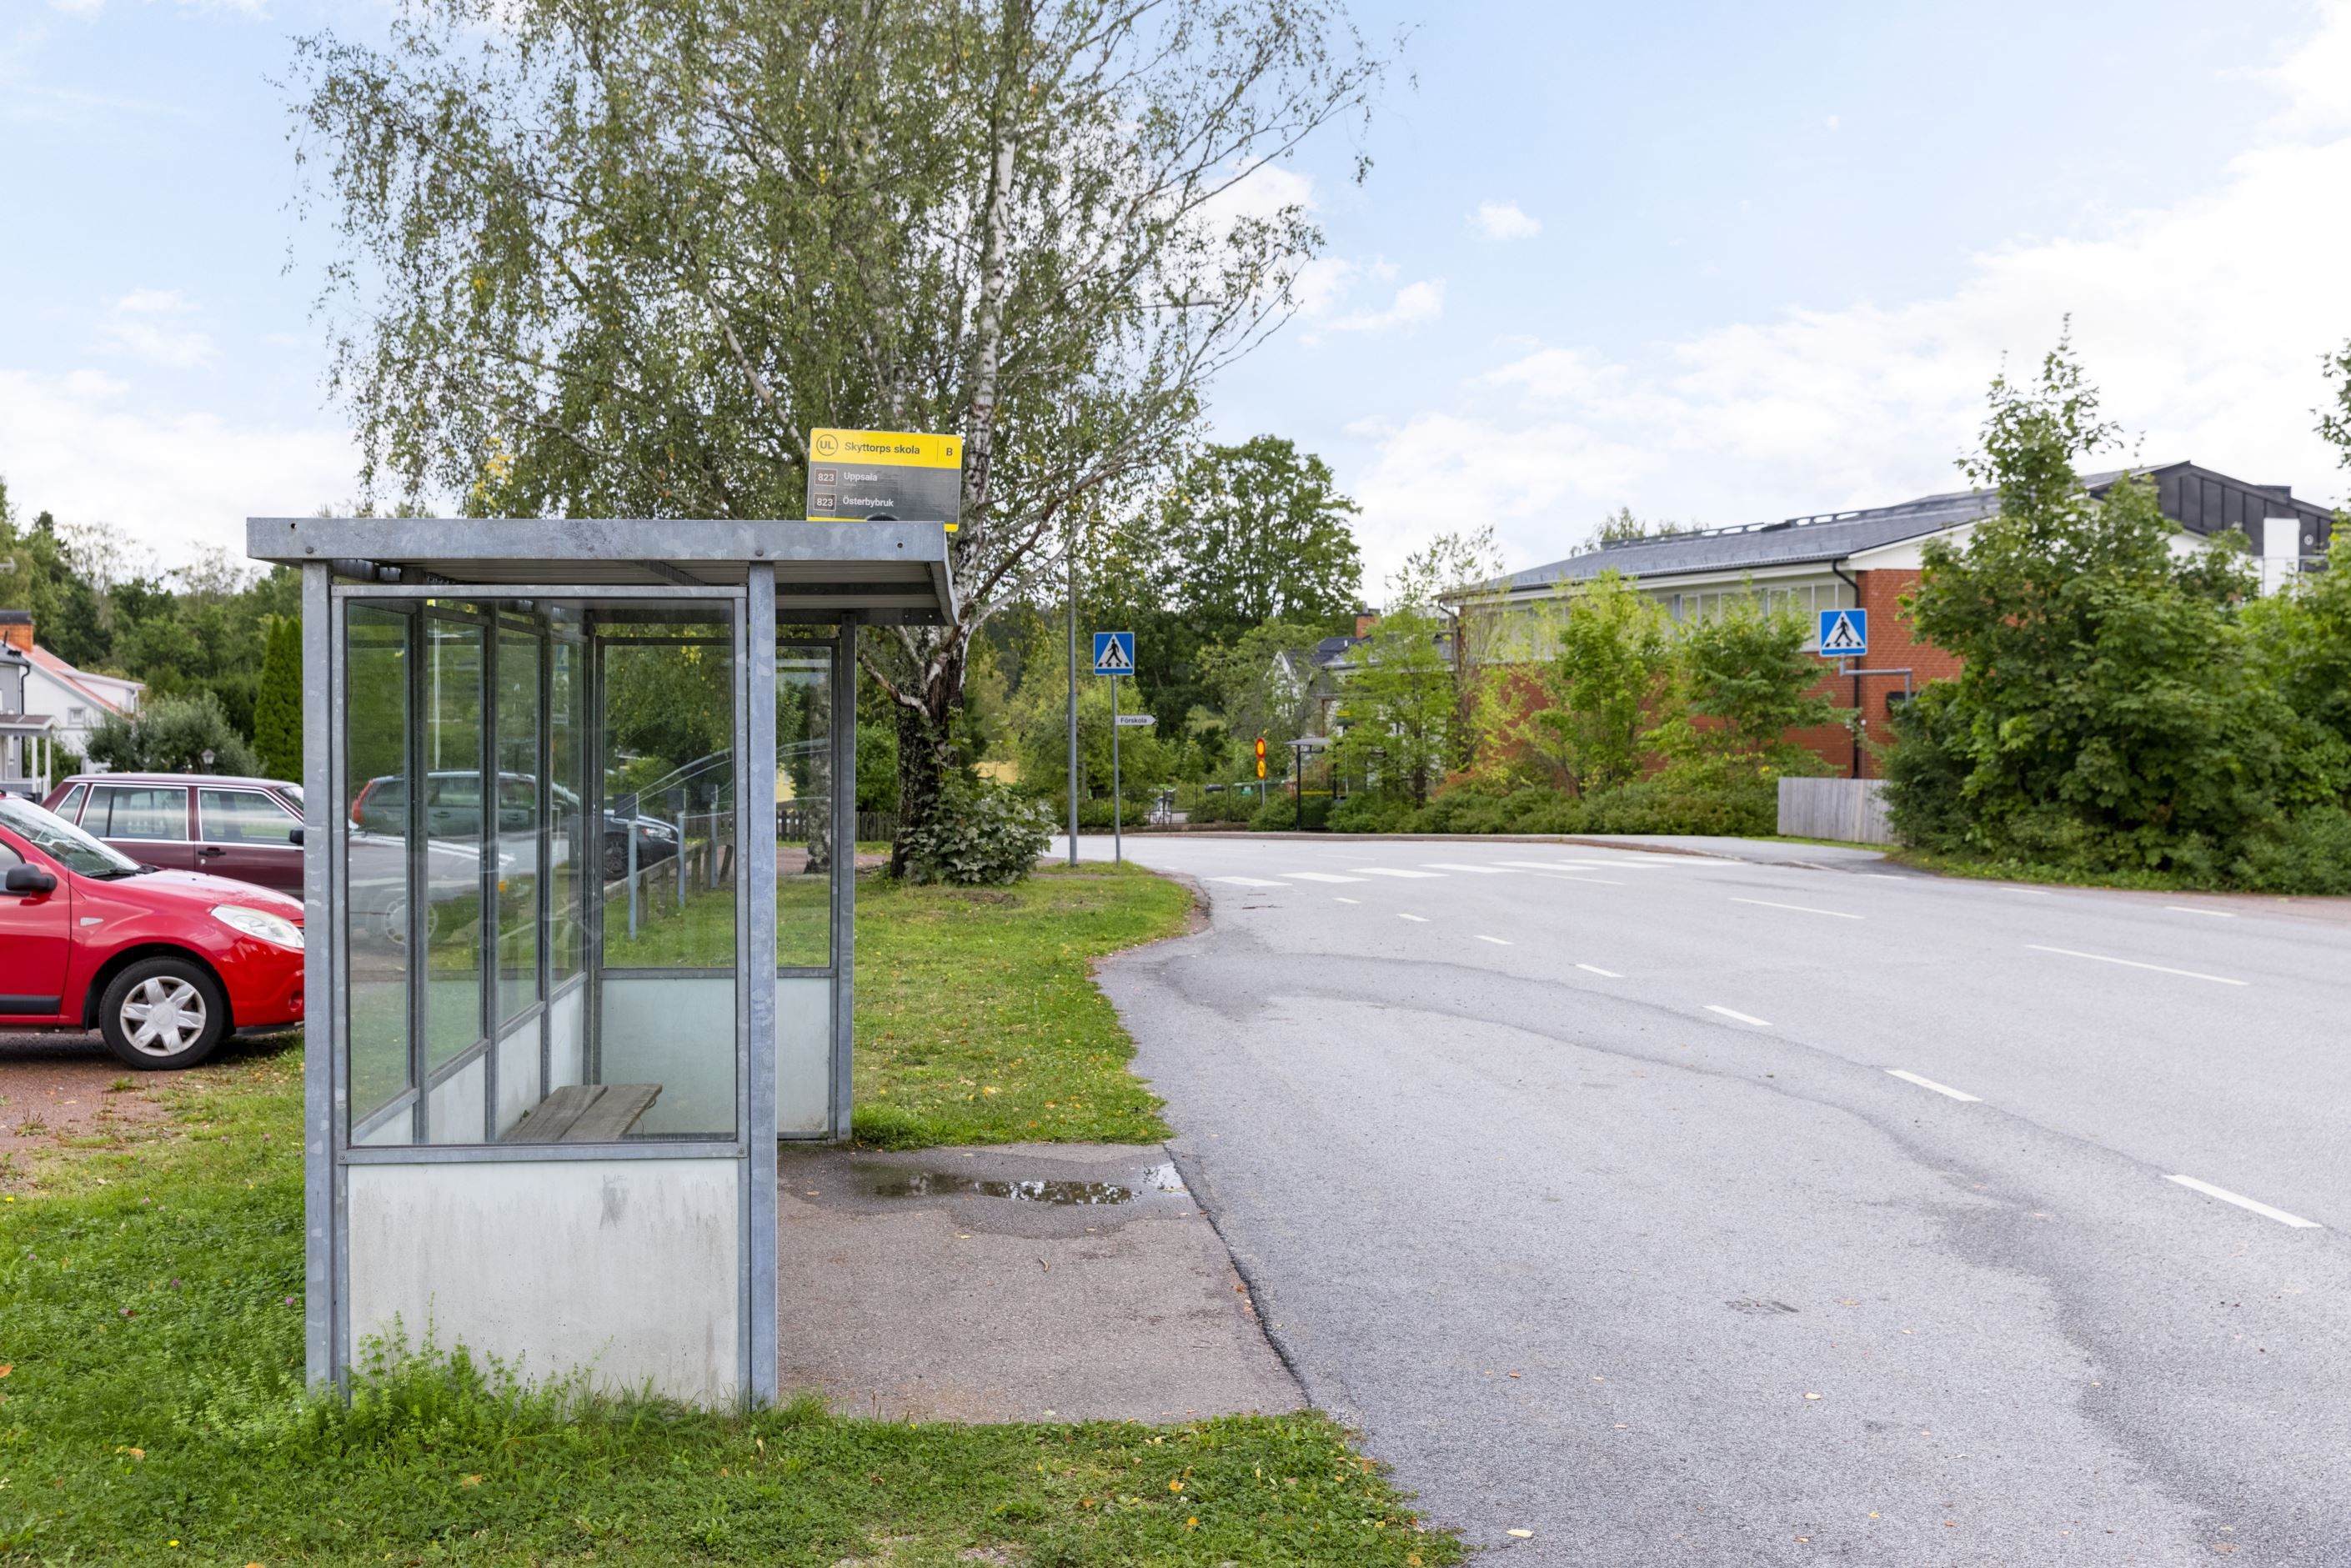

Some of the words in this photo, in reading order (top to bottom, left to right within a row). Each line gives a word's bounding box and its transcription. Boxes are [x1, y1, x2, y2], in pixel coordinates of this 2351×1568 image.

[820, 440, 835, 450] UL
[845, 441, 891, 454] Skyttorps
[894, 444, 920, 454] skola
[946, 448, 953, 456] B
[818, 473, 835, 482] 823
[844, 472, 878, 482] Uppsala
[816, 498, 834, 507] 823
[842, 495, 895, 508] Österbybruk
